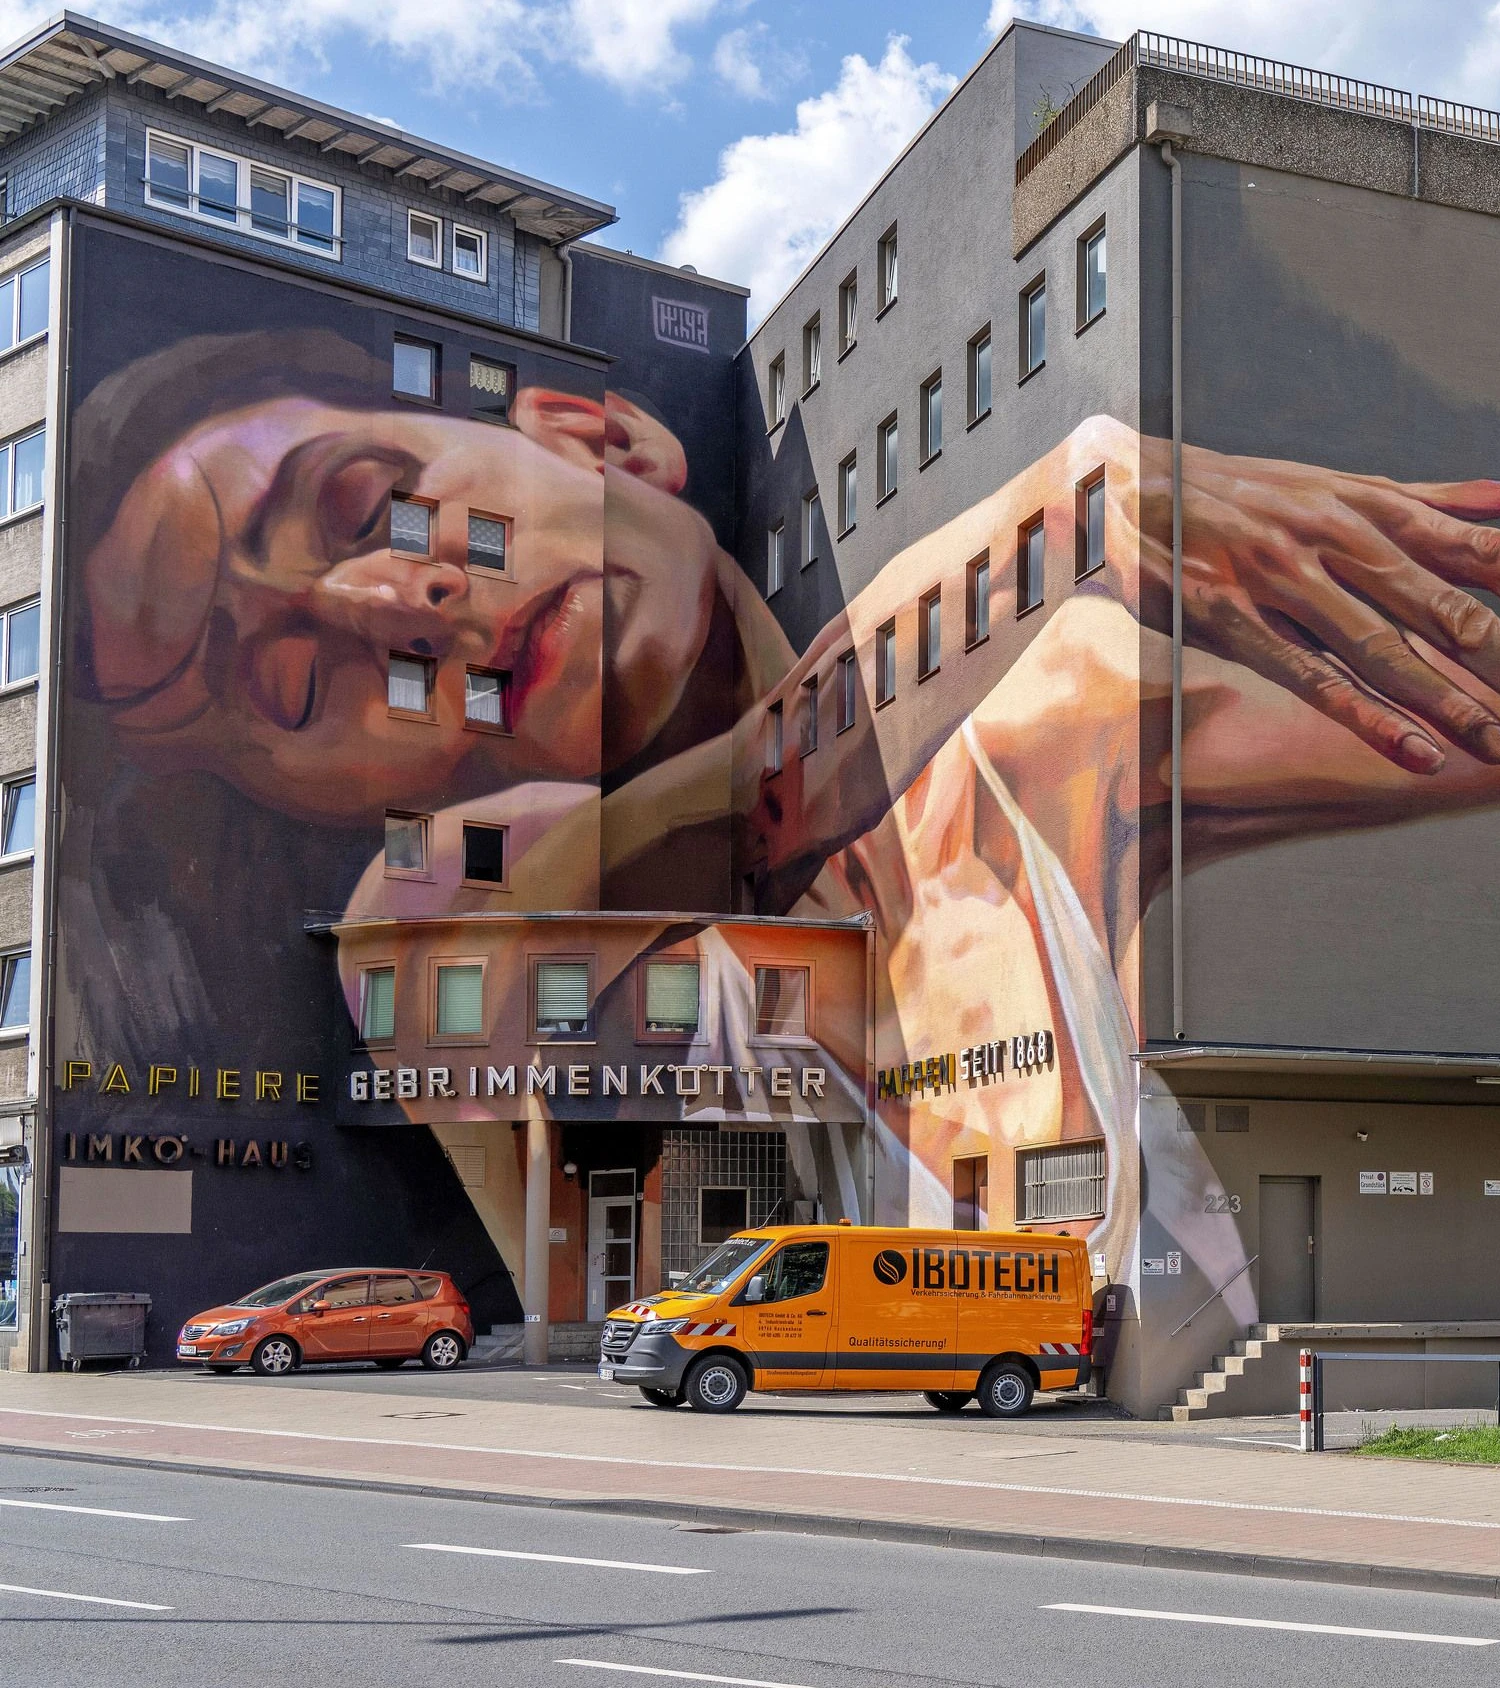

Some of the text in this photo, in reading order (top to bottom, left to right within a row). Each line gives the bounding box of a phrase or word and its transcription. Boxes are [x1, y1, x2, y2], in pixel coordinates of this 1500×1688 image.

[960, 1030, 1051, 1081] SEIT 1868
[63, 1060, 320, 1102] PAPIERE
[469, 1064, 826, 1098] IMMENKÖTTER
[1204, 1194, 1242, 1214] 223
[912, 1248, 1059, 1293] IBOTECH
[911, 1288, 1061, 1301] Verkehrssicherung & Fahrbahnmarkierung
[848, 1336, 947, 1350] Qualitätssicherung!
